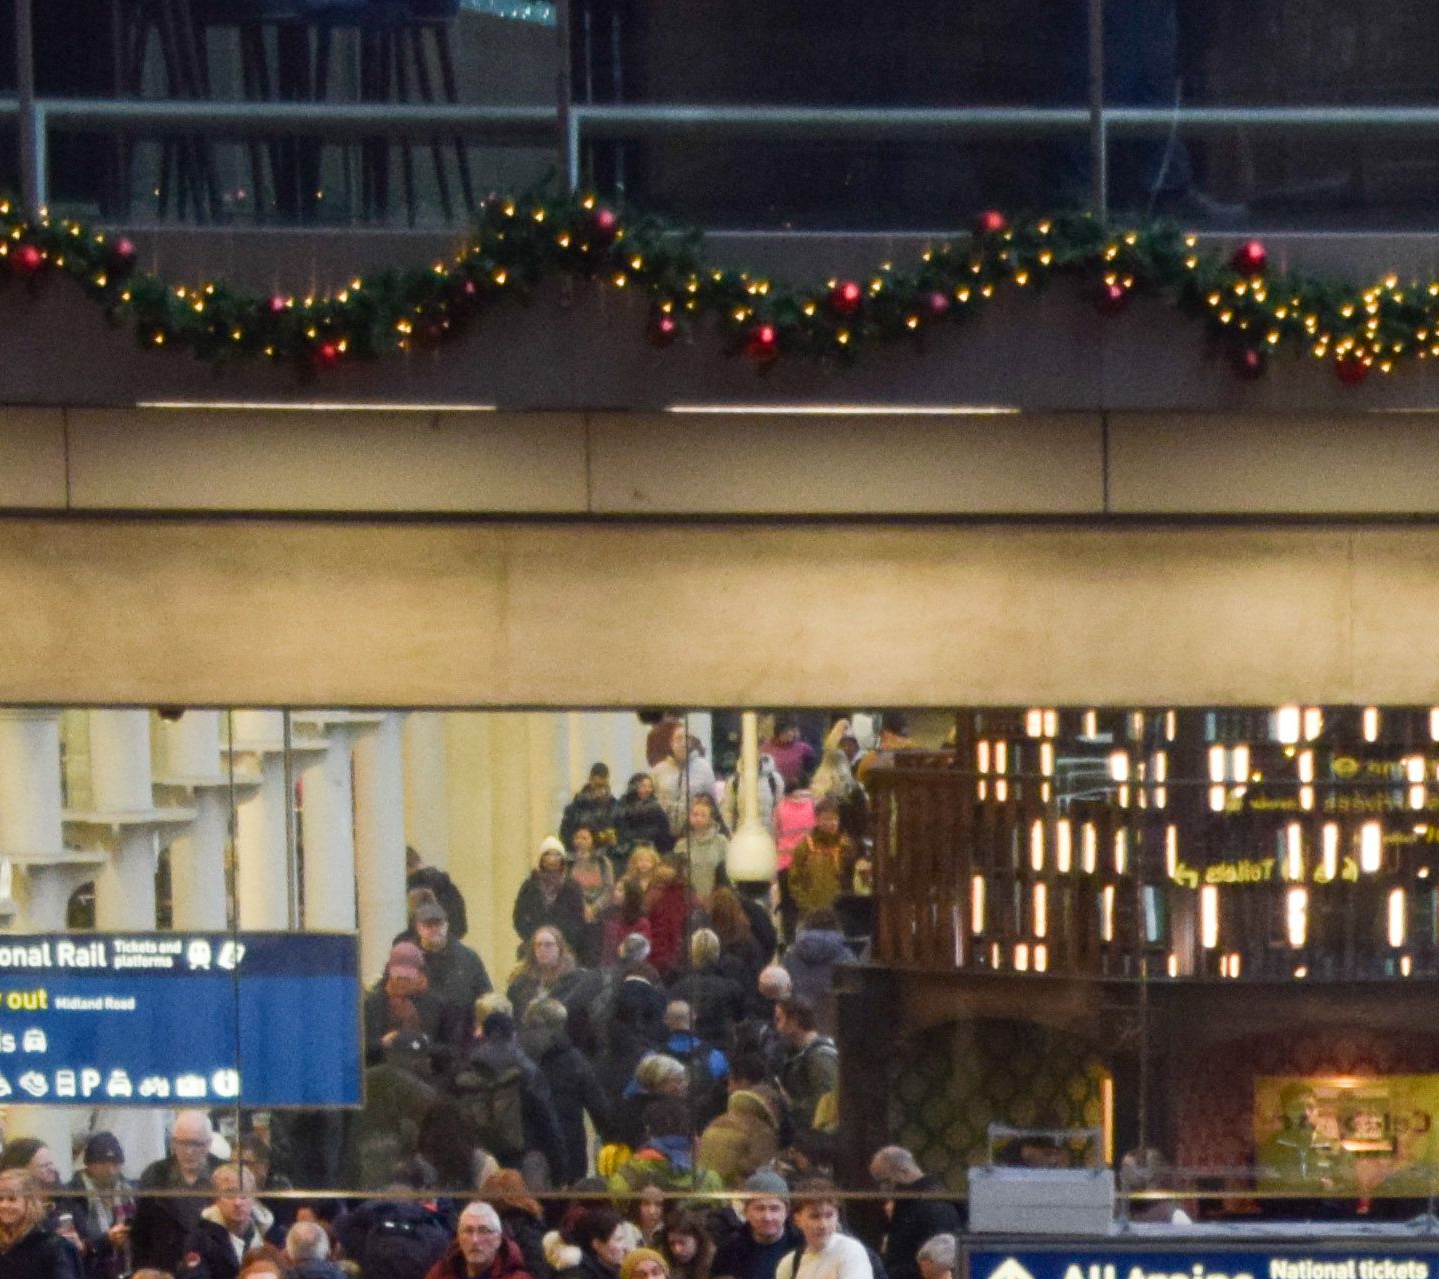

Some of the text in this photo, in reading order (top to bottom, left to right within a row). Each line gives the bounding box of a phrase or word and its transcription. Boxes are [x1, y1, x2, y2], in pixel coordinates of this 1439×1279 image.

[56, 941, 107, 967] Rail
[113, 940, 181, 954] Tickets and
[113, 955, 173, 969] platforms
[6, 989, 47, 1009] out
[55, 997, 135, 1009] Midland Road
[1270, 1260, 1428, 1279] National tickets
